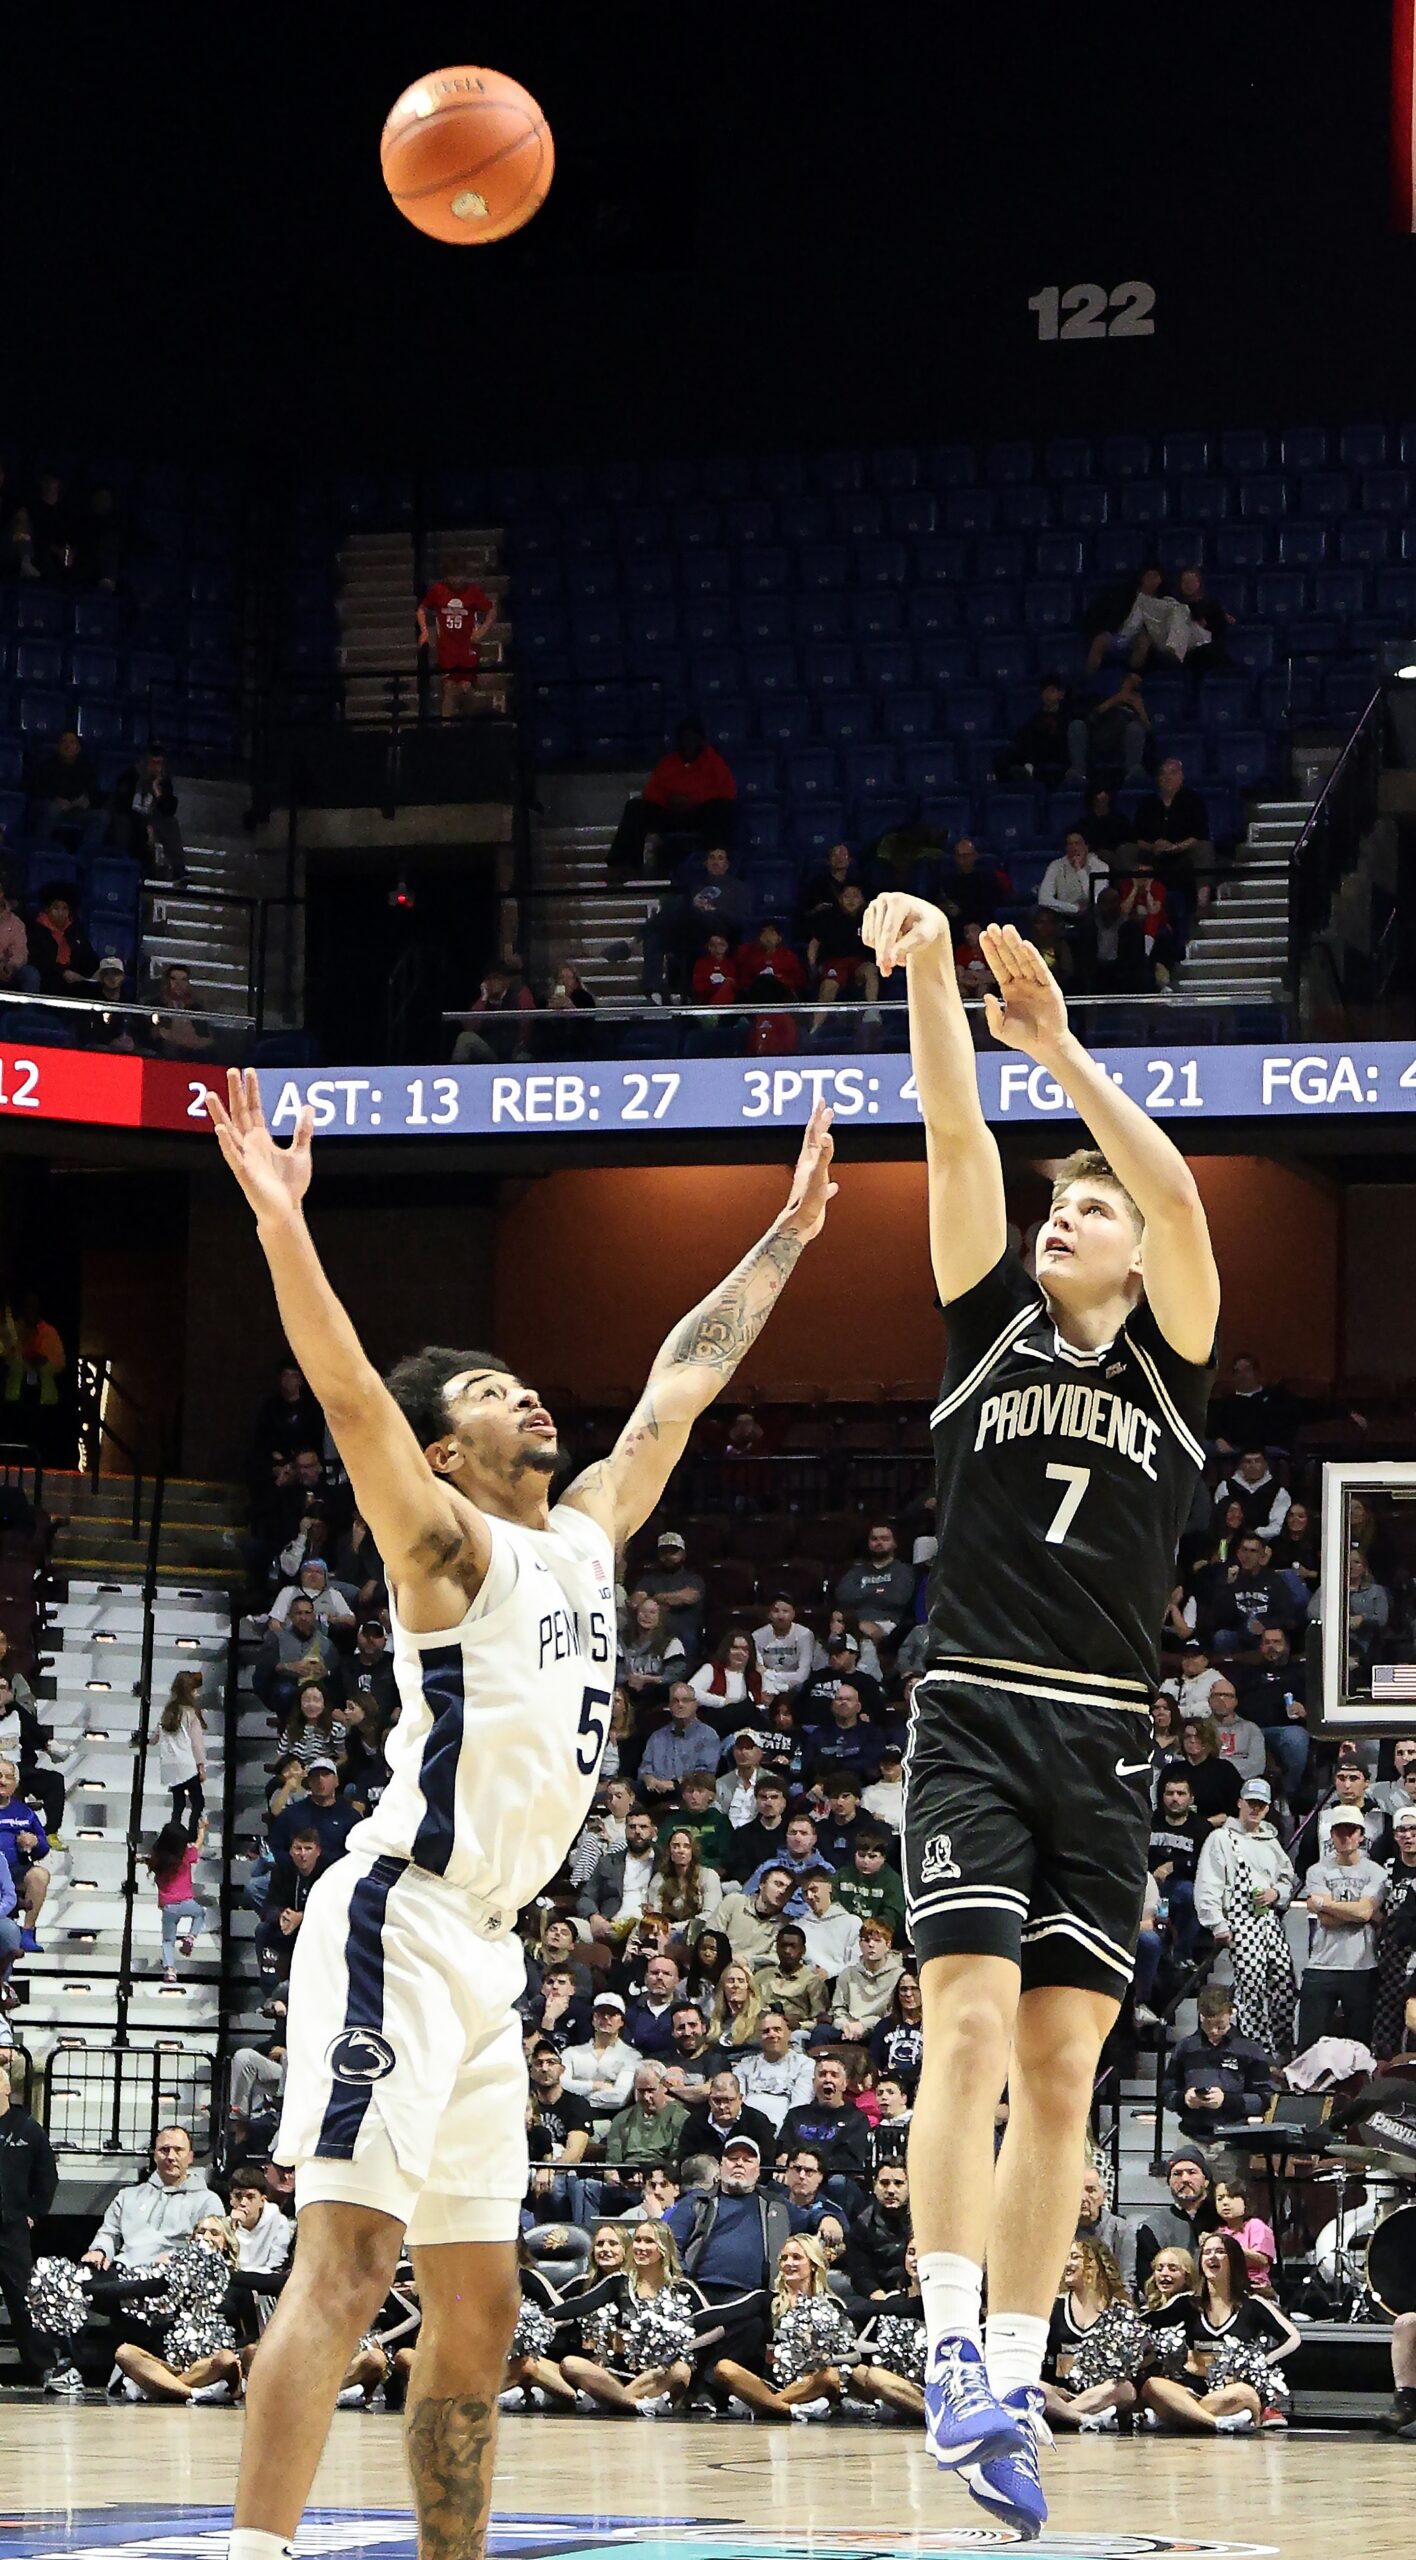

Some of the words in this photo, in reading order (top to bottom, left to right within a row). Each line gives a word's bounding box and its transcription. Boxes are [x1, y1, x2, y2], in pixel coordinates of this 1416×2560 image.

[1028, 281, 1156, 341] 122
[271, 1080, 382, 1127] AST:
[405, 1077, 459, 1125] 13
[492, 1075, 600, 1123] REB:
[621, 1073, 680, 1120] 27
[742, 1067, 879, 1118] 3PTS:
[1145, 1060, 1204, 1107] 21
[1262, 1056, 1378, 1105] FGA:
[974, 1383, 1162, 1482] PROVIDENCE
[1045, 1462, 1091, 1544] 7
[576, 1685, 612, 1776] 5
